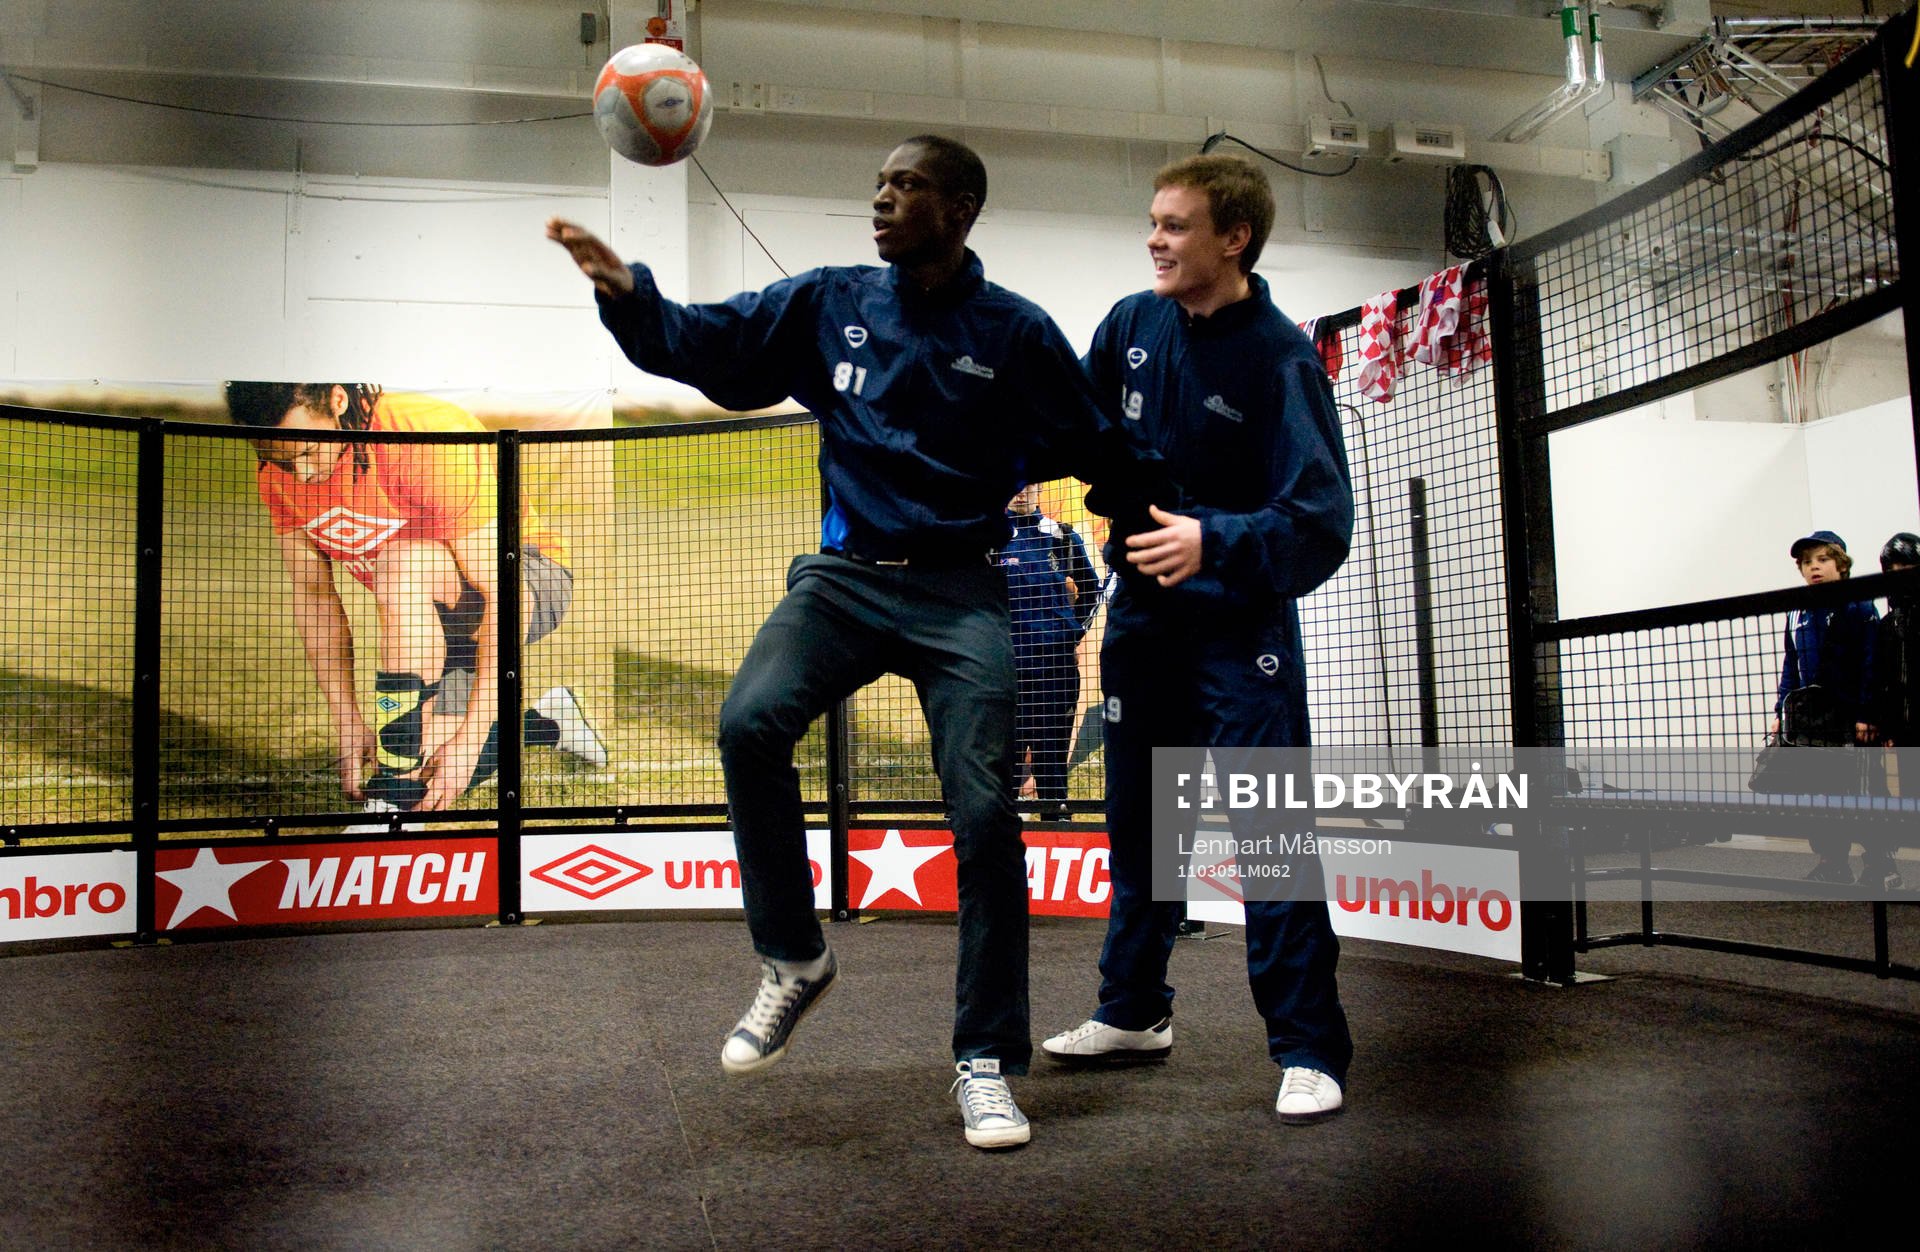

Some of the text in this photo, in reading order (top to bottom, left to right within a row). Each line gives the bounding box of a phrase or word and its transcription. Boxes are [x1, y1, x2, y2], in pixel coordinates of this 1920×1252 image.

[833, 361, 867, 396] 81
[1102, 695, 1122, 723] 9
[278, 852, 486, 910] MATCH
[1024, 846, 1112, 904] ATC
[1335, 869, 1513, 932] umbro
